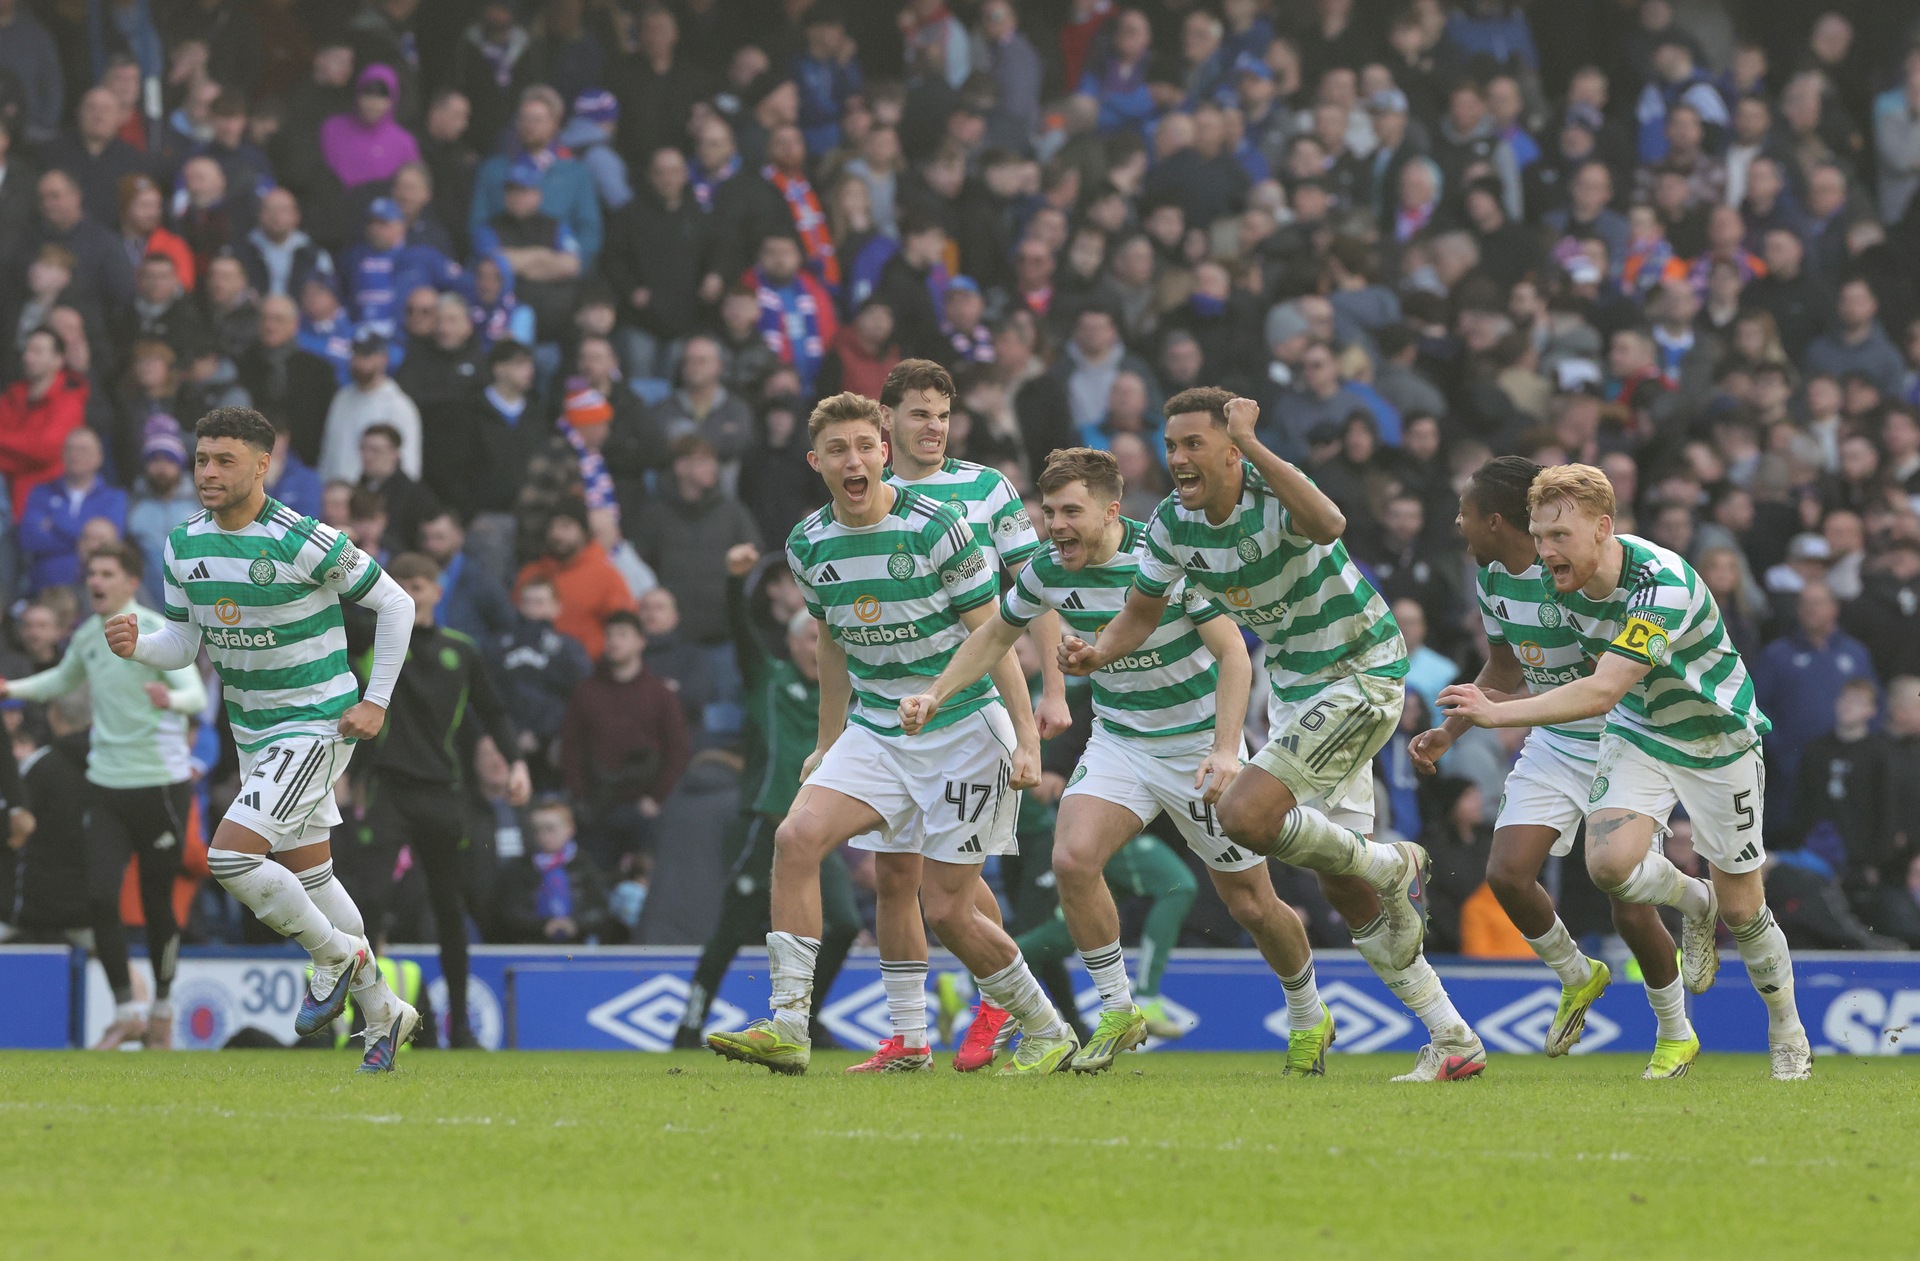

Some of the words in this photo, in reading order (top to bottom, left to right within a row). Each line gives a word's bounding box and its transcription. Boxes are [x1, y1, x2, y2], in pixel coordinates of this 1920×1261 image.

[207, 627, 276, 649] dafabet
[841, 623, 918, 646] dafabet
[1625, 623, 1649, 648] C
[1522, 666, 1583, 684] afabet
[1300, 701, 1338, 731] 6
[252, 746, 294, 783] 21
[945, 781, 991, 823] 47
[1734, 790, 1754, 831] 5
[1189, 801, 1226, 837] 4
[242, 968, 296, 1015] 30
